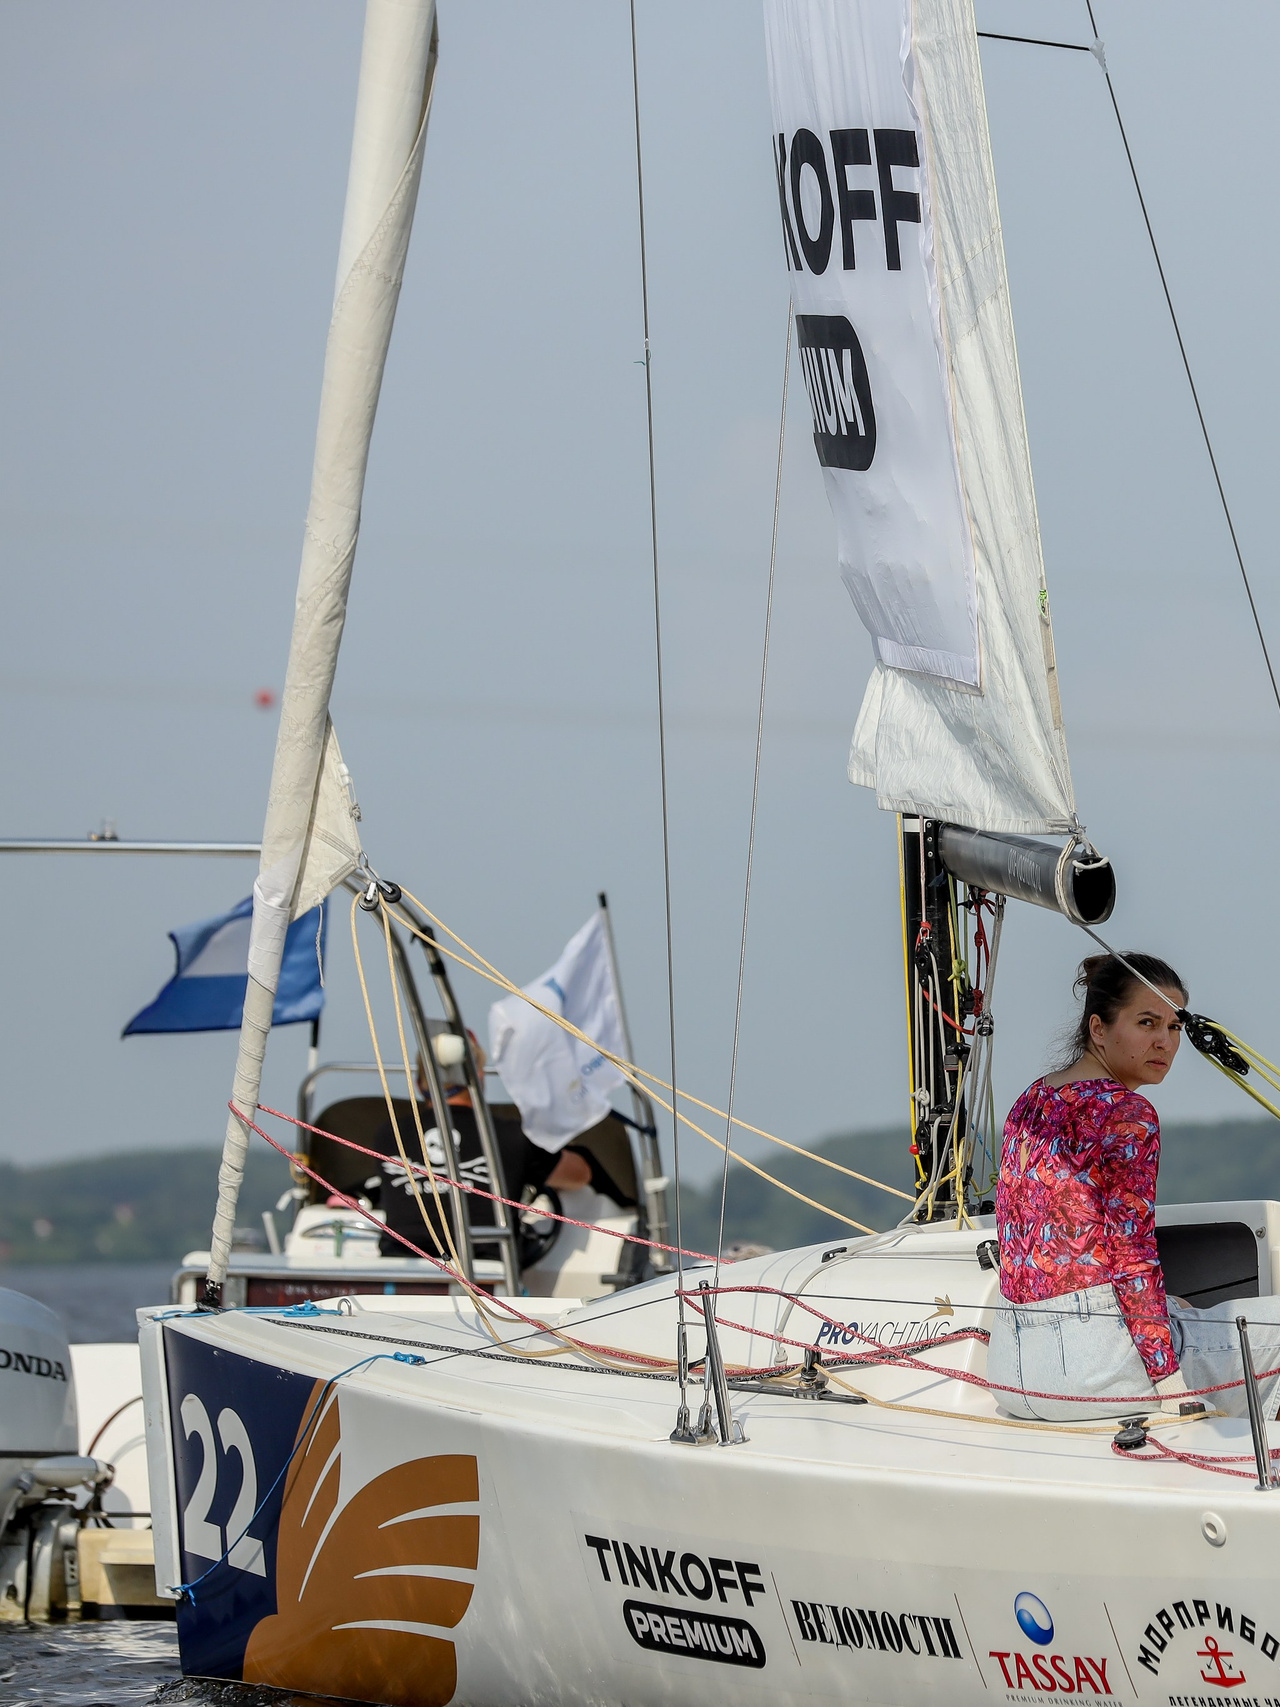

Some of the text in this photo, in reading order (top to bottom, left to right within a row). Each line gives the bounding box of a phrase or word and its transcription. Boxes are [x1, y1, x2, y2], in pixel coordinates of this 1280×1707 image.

[180, 1393, 267, 1578] 22
[585, 1534, 767, 1608] TINKOFF
[629, 1609, 758, 1660] PREMIUM
[790, 1599, 964, 1661] ВЕДОМОСТИ
[989, 1650, 1114, 1696] TASSAY
